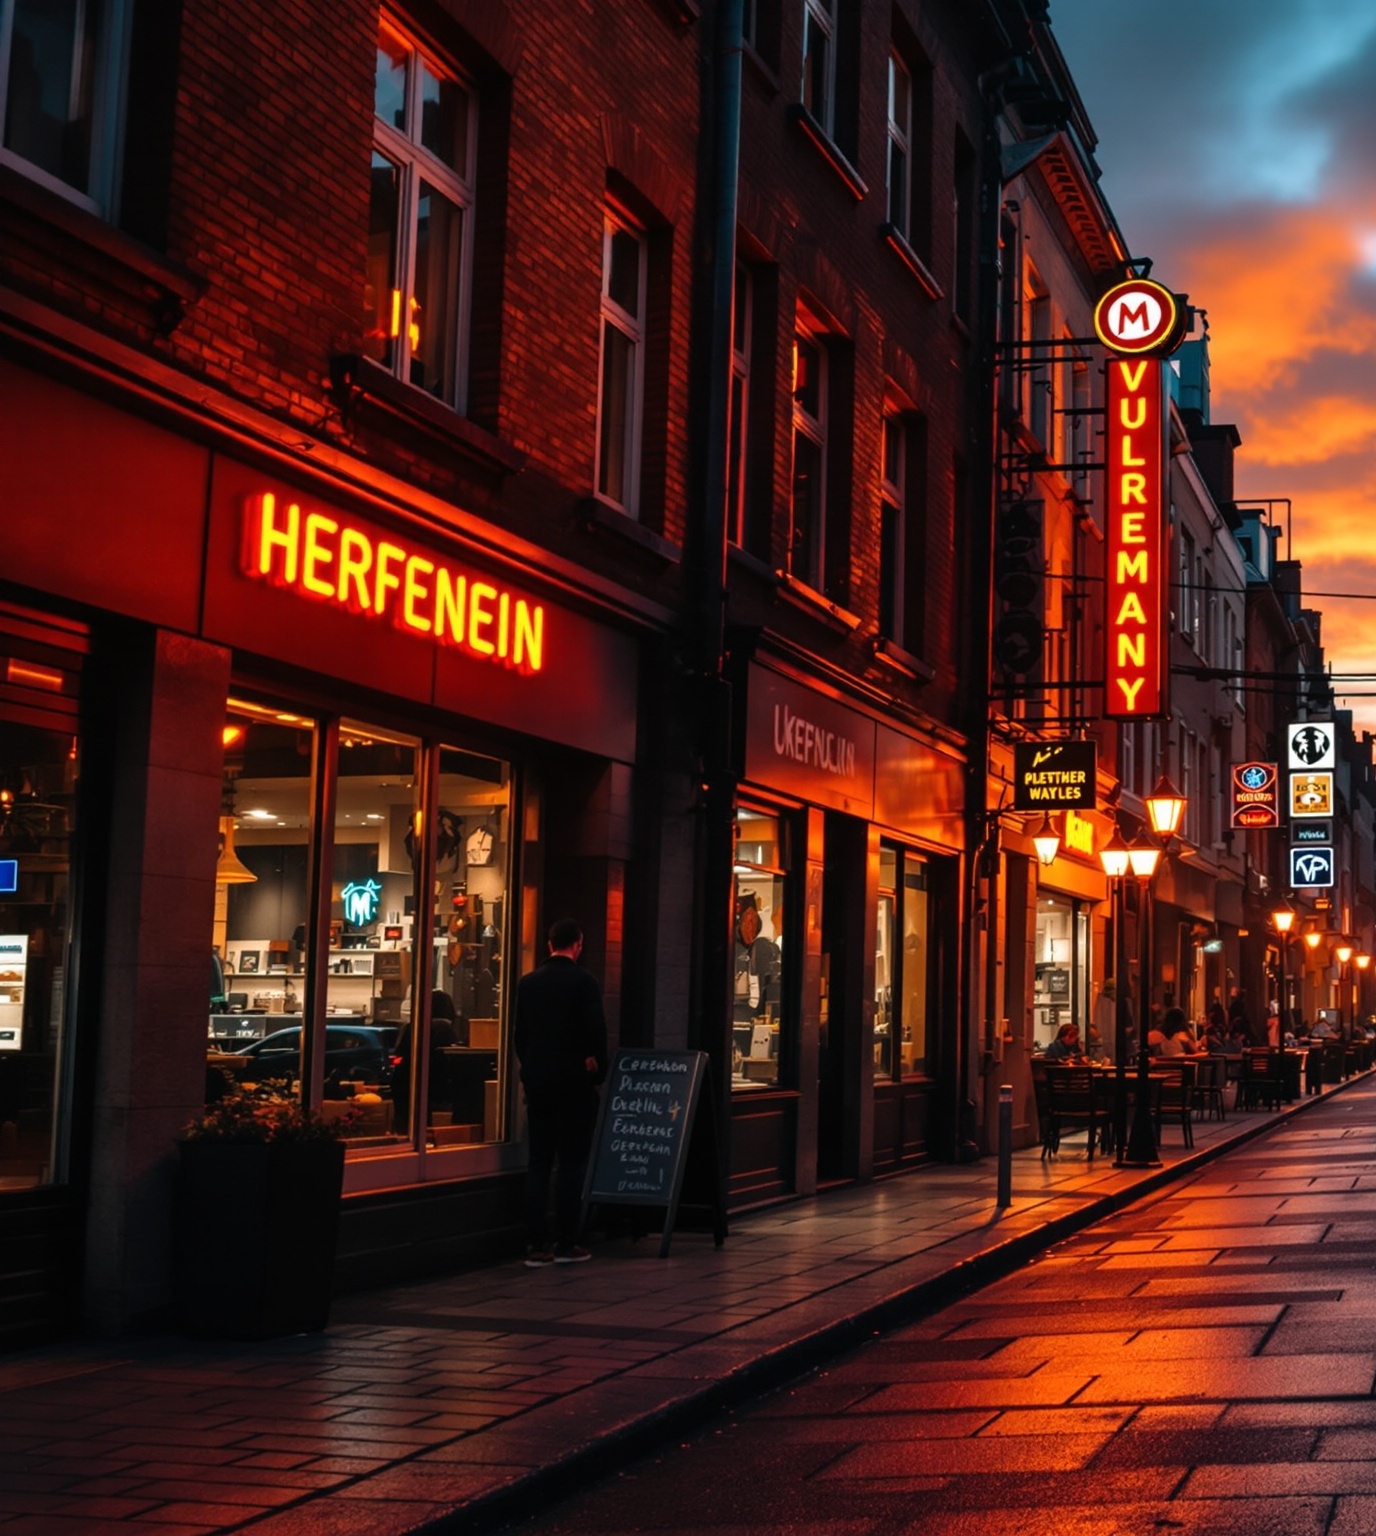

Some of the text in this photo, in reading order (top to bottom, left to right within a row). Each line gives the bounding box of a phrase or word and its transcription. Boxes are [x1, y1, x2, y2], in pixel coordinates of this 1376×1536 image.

[1118, 301, 1150, 336] M
[259, 492, 544, 671] HERFENEIN
[1115, 360, 1148, 711] VULREMANY
[1029, 786, 1082, 801] WAYLES
